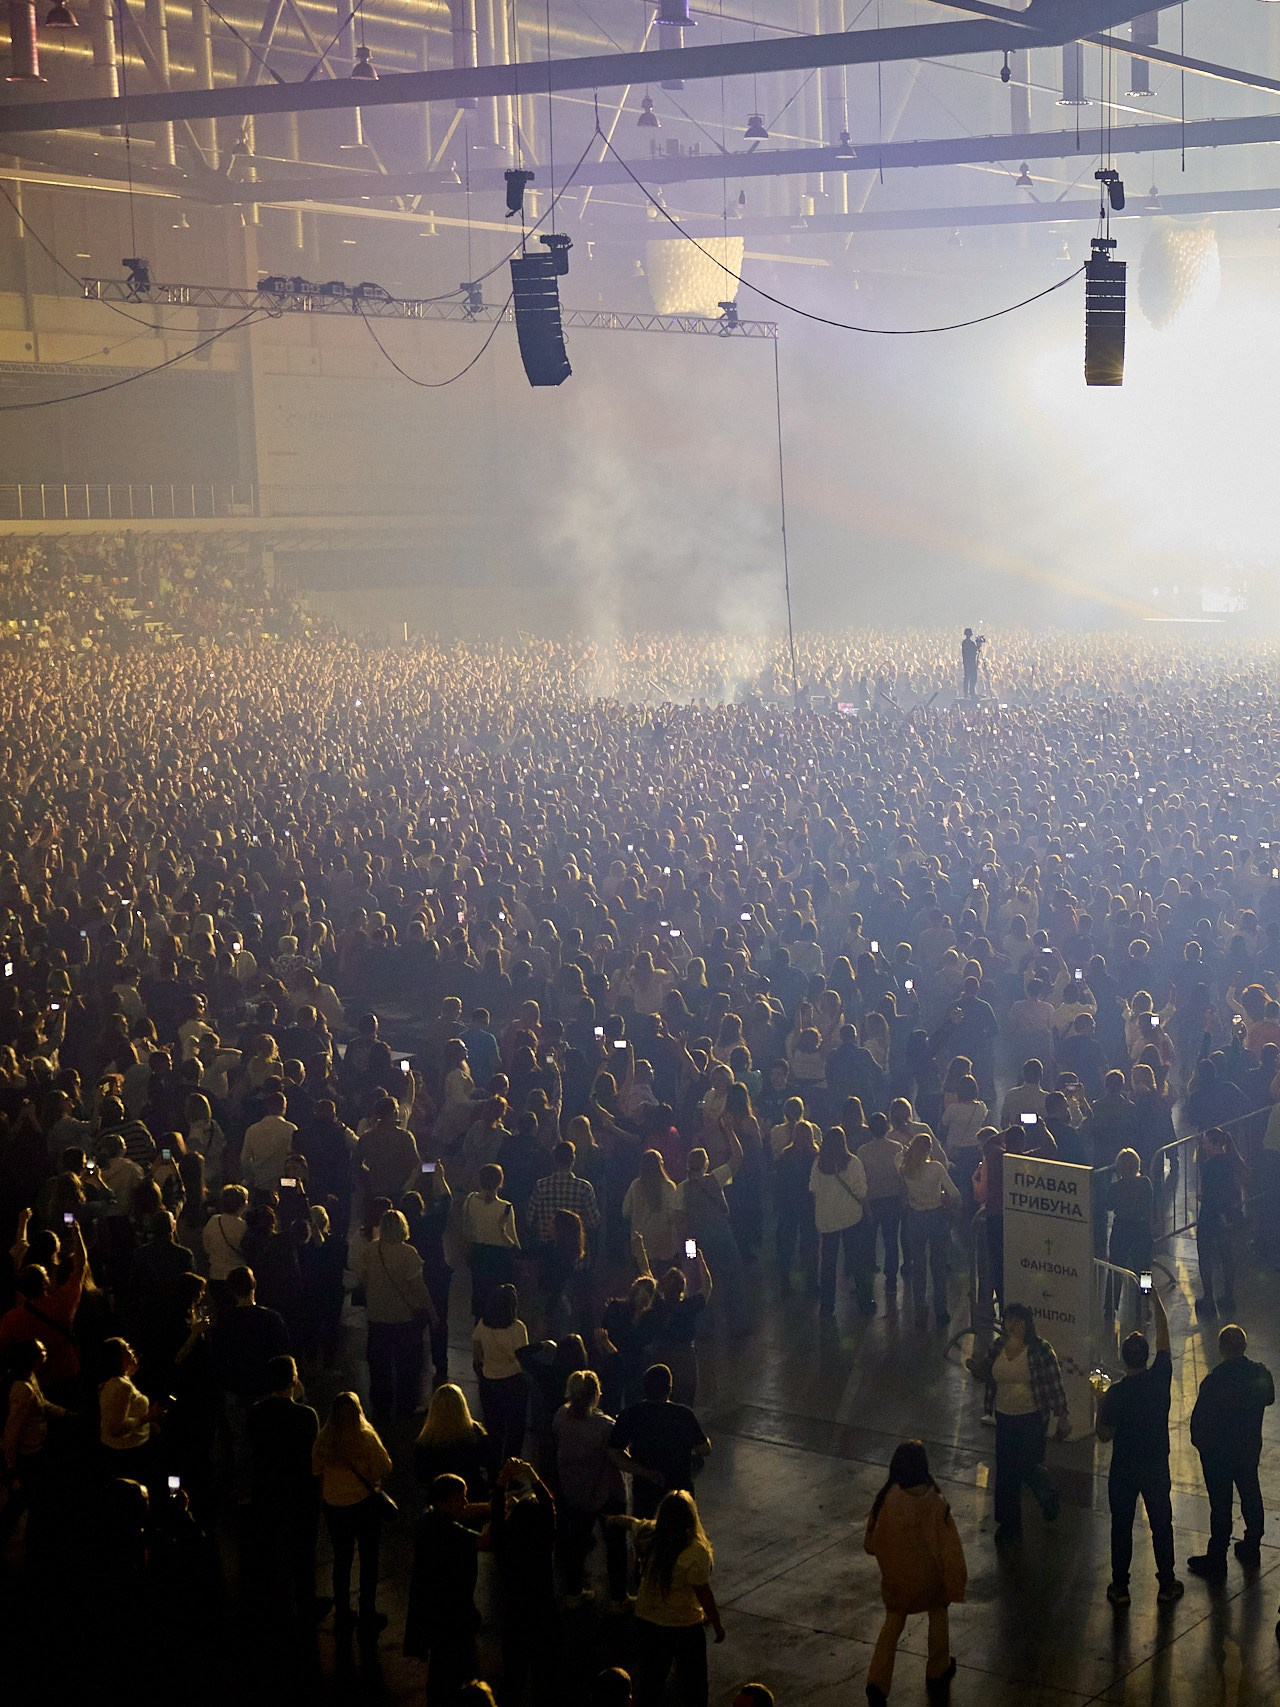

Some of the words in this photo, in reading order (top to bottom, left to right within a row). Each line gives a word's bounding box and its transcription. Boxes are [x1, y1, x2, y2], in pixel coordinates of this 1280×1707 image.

[1015, 1173, 1077, 1195] ПРАВАЯ
[1009, 1193, 1083, 1217] ТРИБУНА
[1020, 1258, 1078, 1278] ФАНЗОНА
[1026, 1305, 1076, 1325] НЦПОЛ
